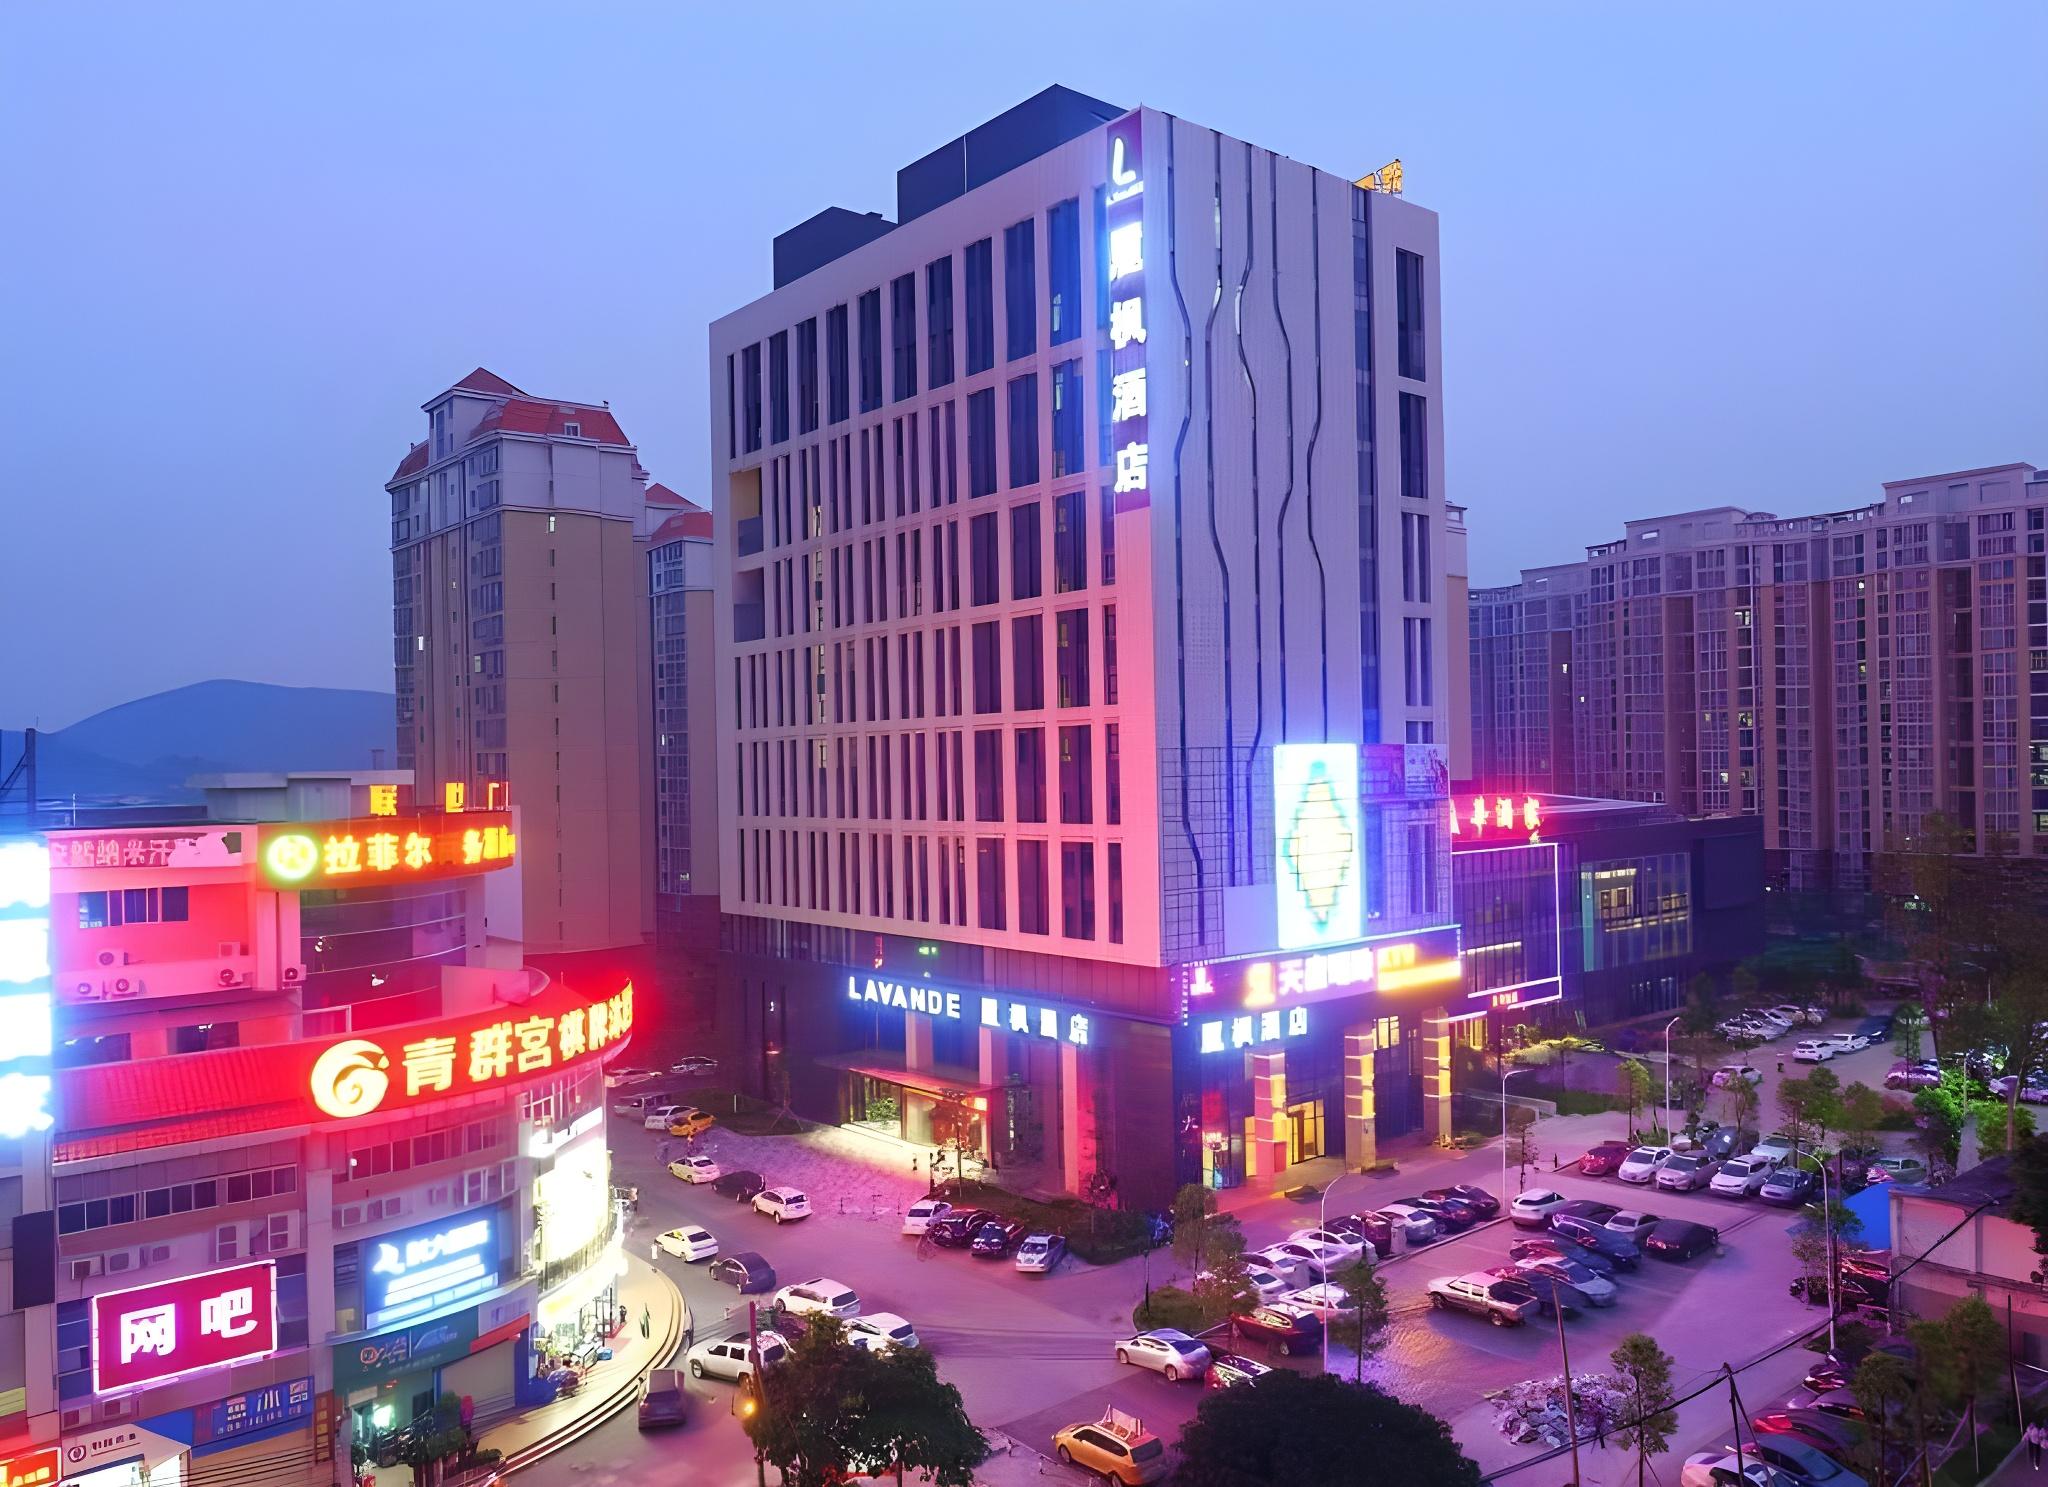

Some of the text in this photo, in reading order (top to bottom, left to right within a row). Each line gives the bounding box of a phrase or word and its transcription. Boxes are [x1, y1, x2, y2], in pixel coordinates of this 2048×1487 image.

[1109, 221, 1149, 493] 枫酒店
[323, 825, 515, 875] 拉菲尔务
[848, 976, 961, 1020] LAVANDE
[120, 1286, 258, 1365] 网吧
